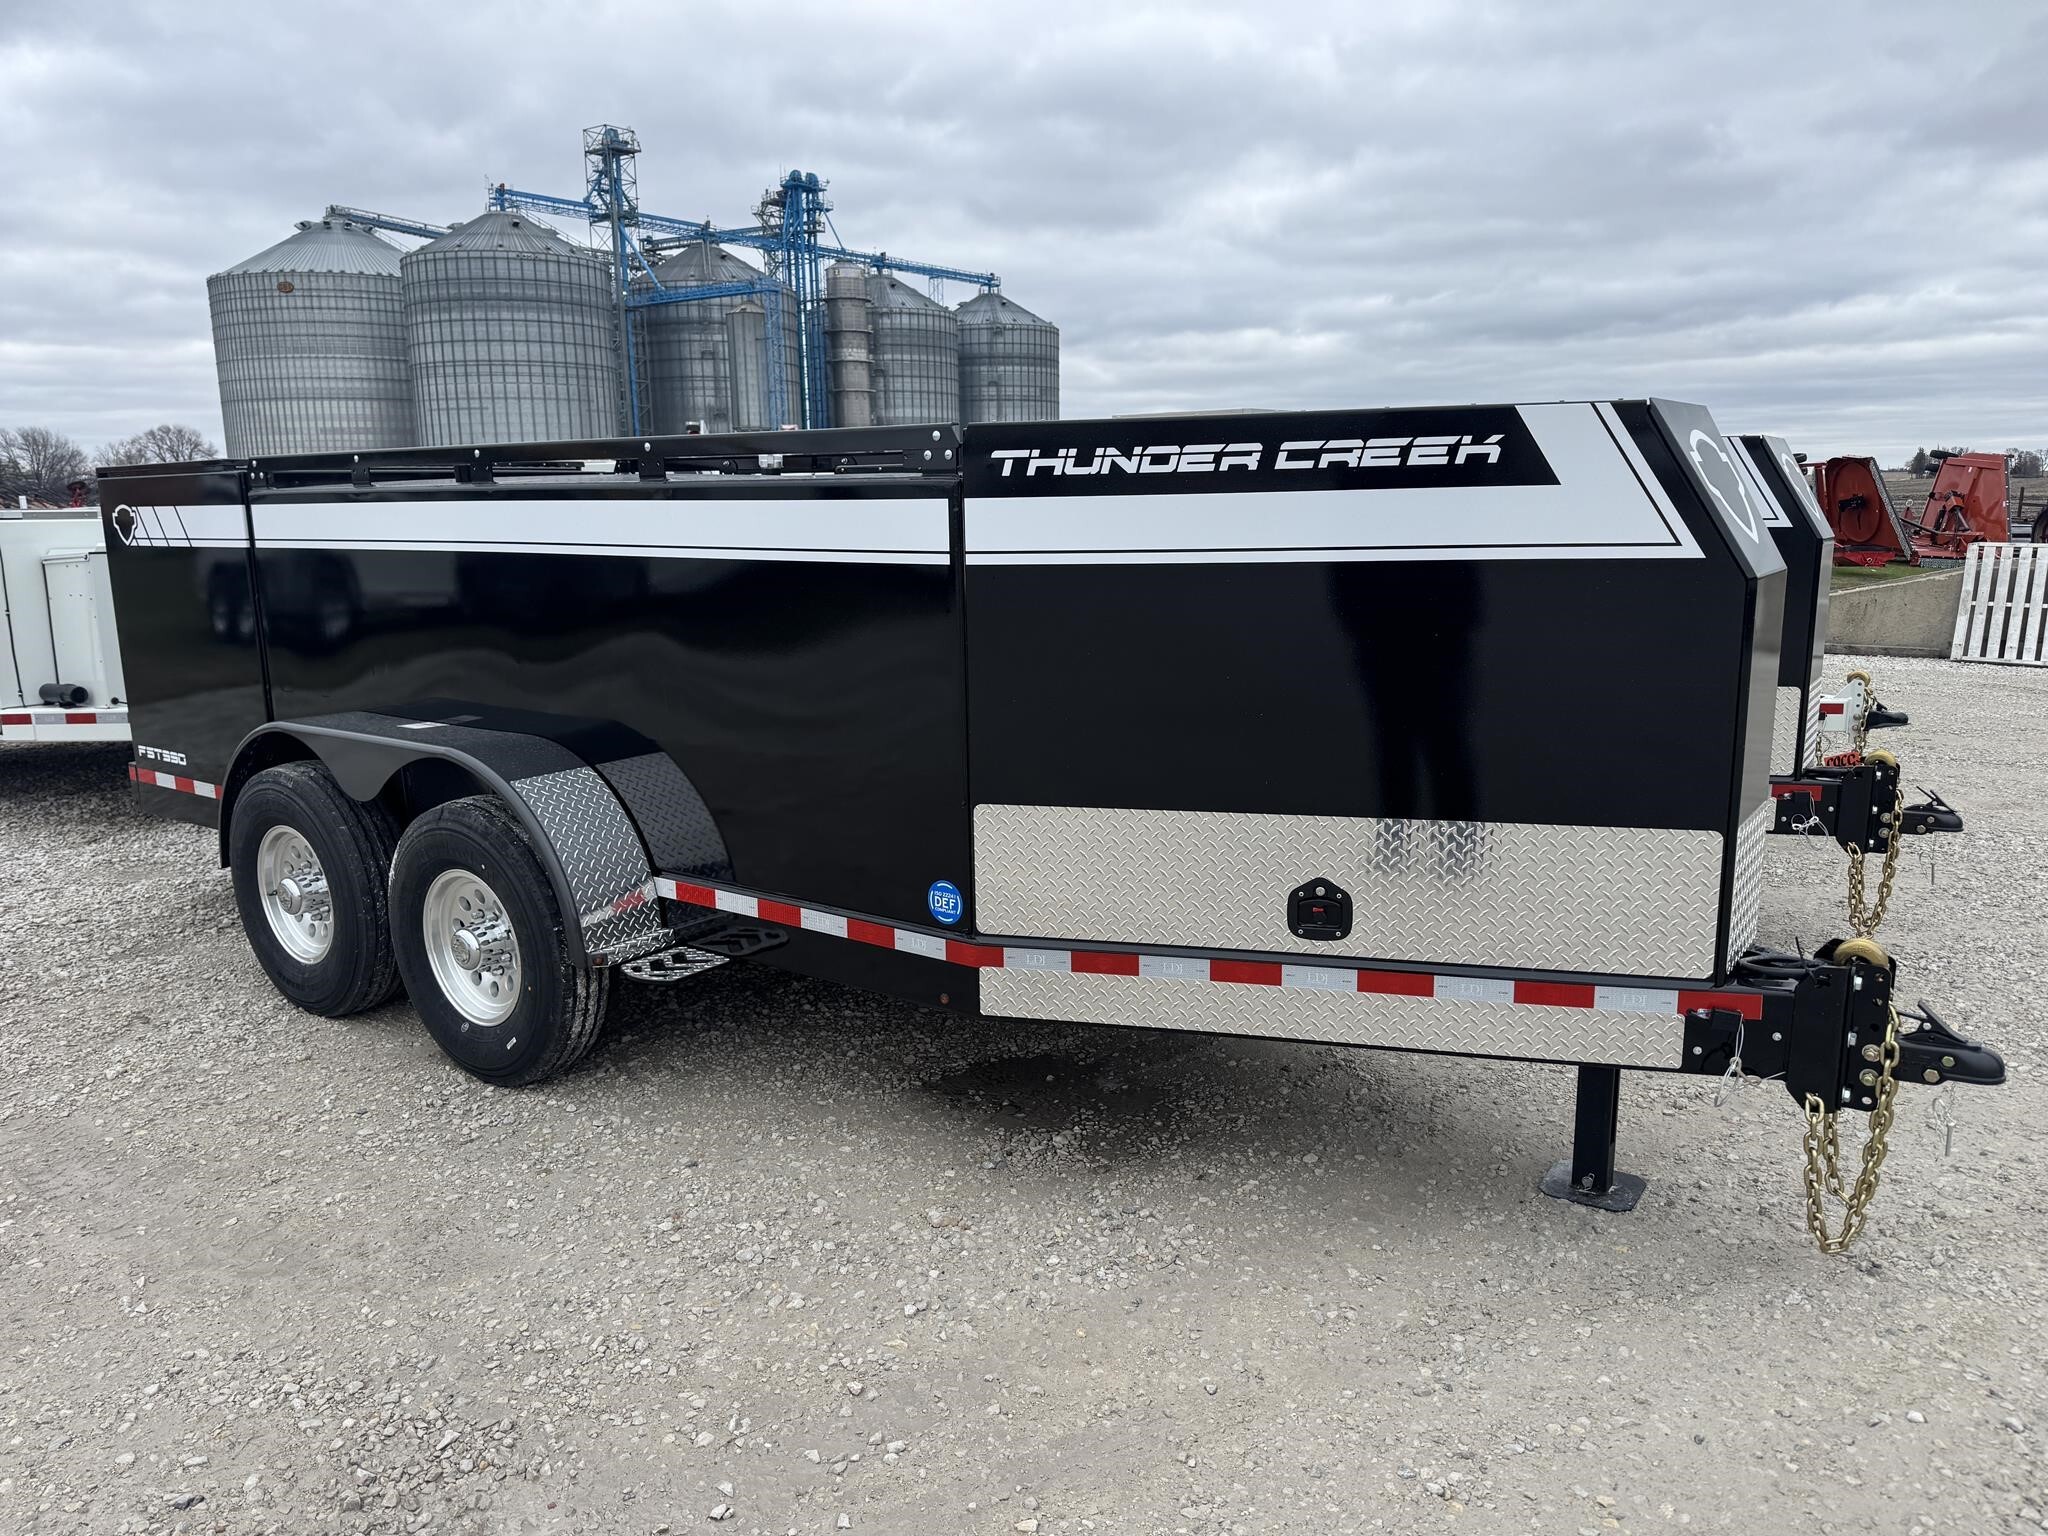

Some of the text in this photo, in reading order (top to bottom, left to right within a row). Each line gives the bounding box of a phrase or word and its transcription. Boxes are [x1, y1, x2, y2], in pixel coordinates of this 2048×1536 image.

[991, 434, 1504, 476] THUNDER CREEK
[934, 896, 956, 909] DEF
